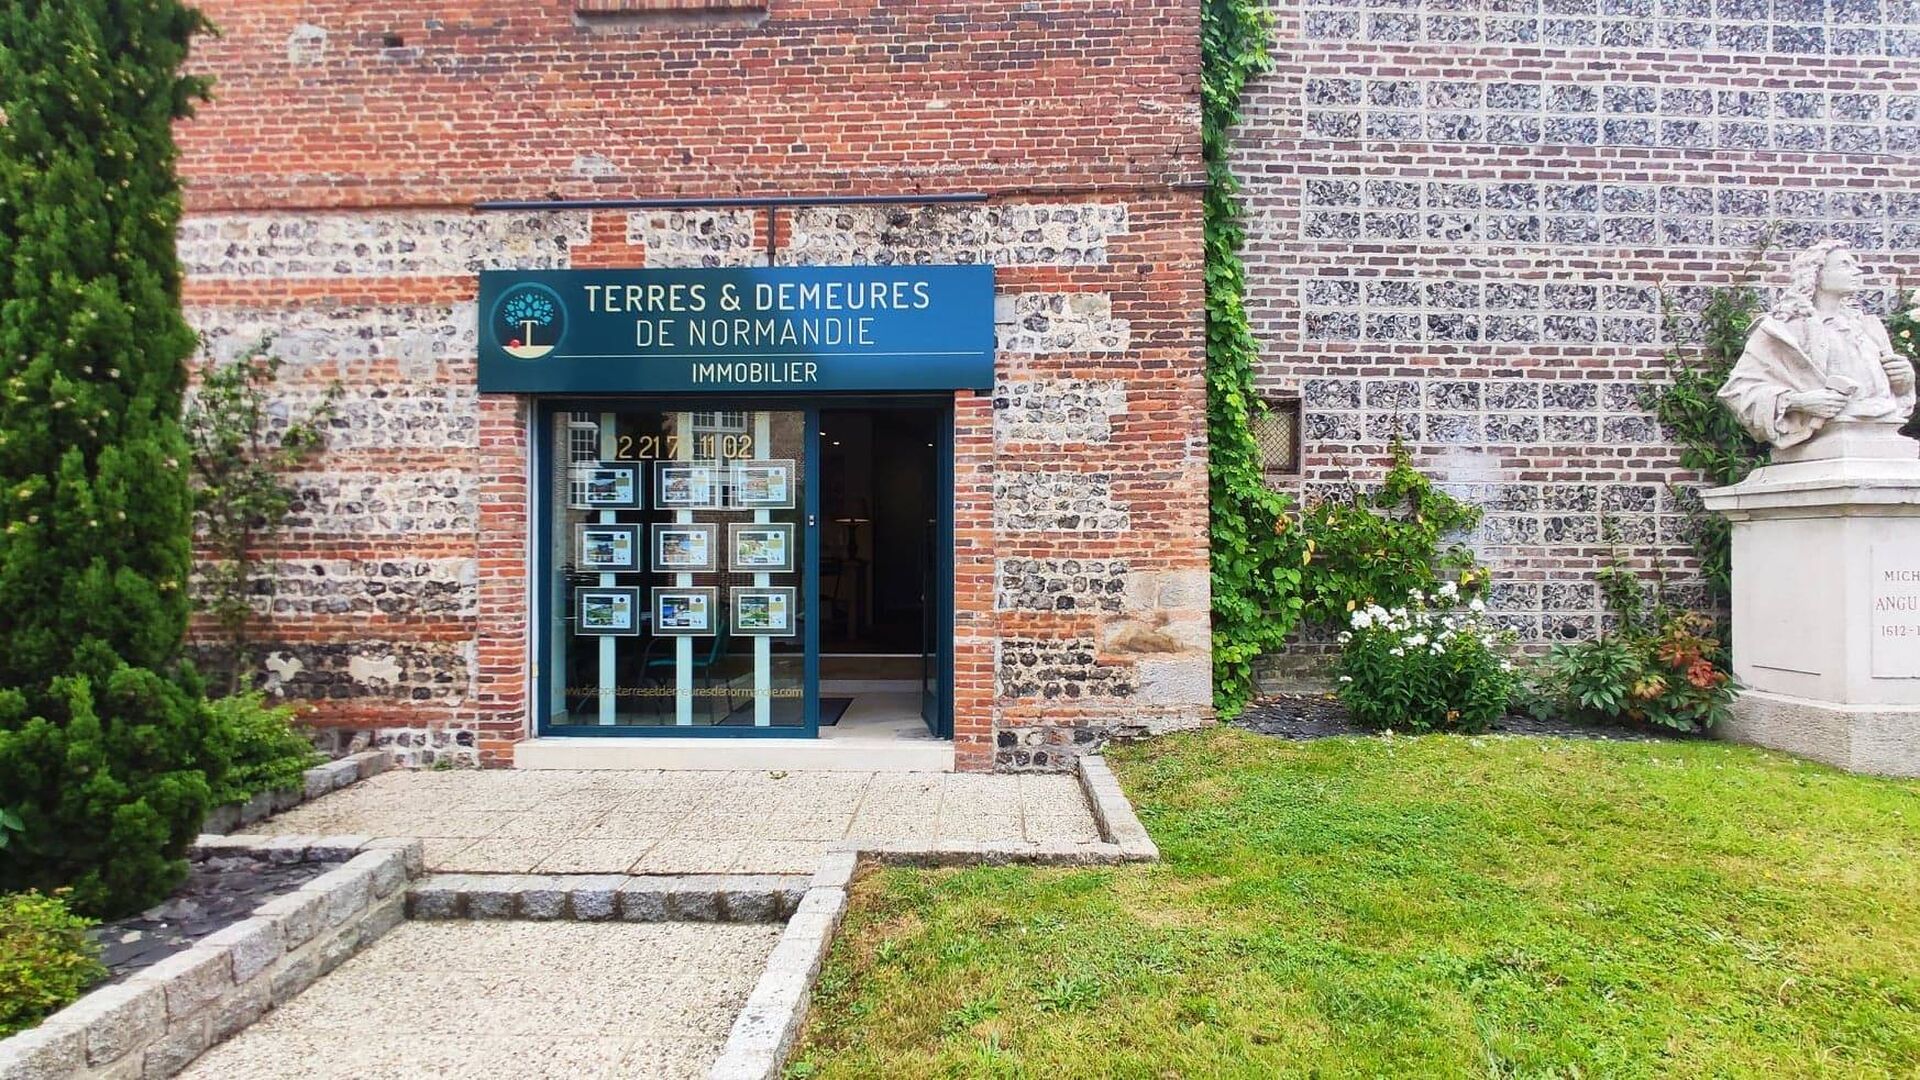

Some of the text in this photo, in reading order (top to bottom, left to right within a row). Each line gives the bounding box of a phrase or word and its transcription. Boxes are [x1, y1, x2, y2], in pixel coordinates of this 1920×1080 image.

[584, 281, 930, 312] TERRES & DEMEURES
[636, 317, 874, 347] DE NORMANDIE
[692, 362, 818, 383] IMMOBILIER
[639, 435, 660, 459] 21
[667, 435, 694, 459] 7
[700, 435, 715, 459] 11
[723, 435, 752, 459] 02
[1884, 570, 1920, 582] MICH
[1875, 596, 1917, 611] ANGU
